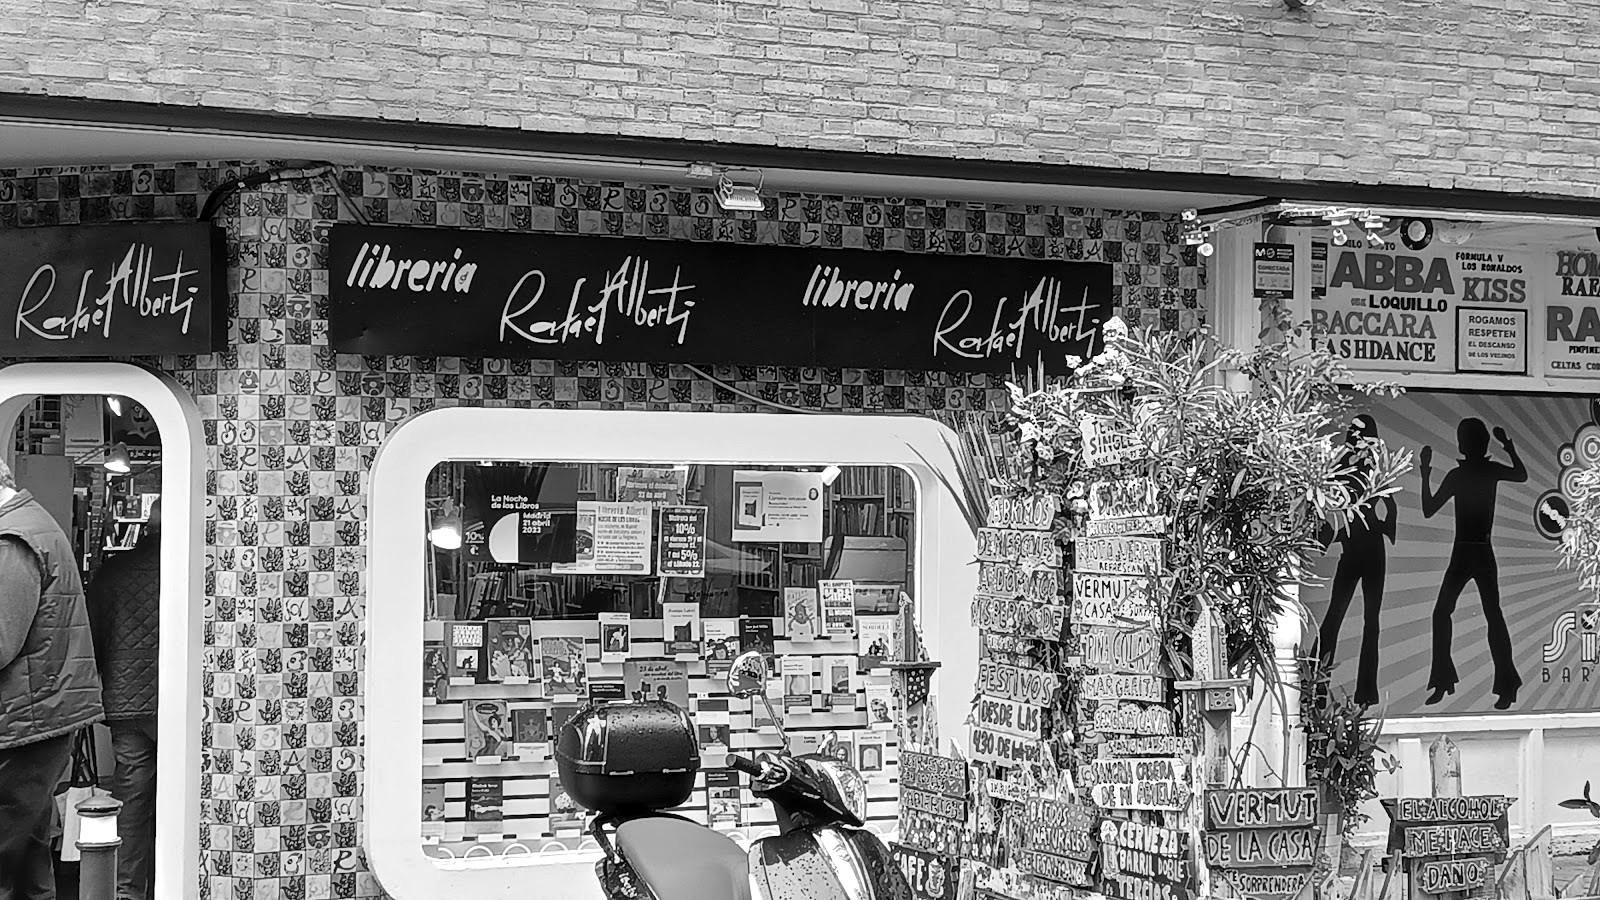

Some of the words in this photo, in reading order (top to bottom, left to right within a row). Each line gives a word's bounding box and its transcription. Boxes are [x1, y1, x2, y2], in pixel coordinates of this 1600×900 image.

[1456, 252, 1493, 262] FORMULA
[1497, 254, 1504, 262] V
[1461, 262, 1477, 271] LOS
[1481, 263, 1523, 274] RONALDOS
[1329, 251, 1455, 295] ABBA
[15, 263, 115, 340] Rafael
[105, 242, 200, 335] Alberti
[500, 269, 610, 345] Rafael
[600, 255, 696, 345] Alberti
[1462, 277, 1527, 303] KISS
[1369, 294, 1448, 312] LOQUILLO
[934, 289, 1027, 359] Rafael
[1018, 276, 1101, 359] Alberti
[1311, 309, 1437, 339] BACCARA
[1468, 315, 1516, 326] ROGAMOS
[1547, 305, 1600, 342] RA
[1468, 328, 1516, 338] RESPETEN
[1478, 341, 1516, 349] DESCANSO
[1551, 361, 1581, 370] CELTAS
[1090, 433, 1135, 456] SINGLE
[515, 502, 539, 510] Libros
[990, 498, 1050, 526] ABRIMOS
[675, 523, 696, 535] 10%
[681, 549, 698, 561] 5%
[1075, 579, 1130, 599] VERMUT
[1084, 601, 1113, 618] CASA
[977, 663, 1052, 705] FESTIVOS
[1086, 675, 1160, 698] MARGARITA
[1541, 667, 1590, 683] BAR
[981, 700, 1013, 728] DESDE
[1017, 704, 1039, 733] LAS
[998, 736, 1011, 759] DE
[1136, 760, 1175, 781] CASERA
[1101, 785, 1116, 807] DE
[1137, 782, 1178, 807] ABUELA
[1210, 789, 1317, 826] VERMUT
[1401, 799, 1421, 820] EL
[1426, 798, 1499, 819] ALCOHOL
[1032, 826, 1088, 852] NATURALES
[1120, 820, 1178, 857] CERVEZA
[1205, 832, 1231, 865] DE
[1236, 830, 1264, 862] LA
[1267, 829, 1314, 864] CASA
[1411, 829, 1440, 856] ME
[1444, 826, 1492, 853] HACE
[1120, 849, 1155, 876] BARRIL
[1157, 857, 1184, 882] DOBLE
[1223, 869, 1239, 884] TE
[1116, 874, 1171, 900] TERCIOS
